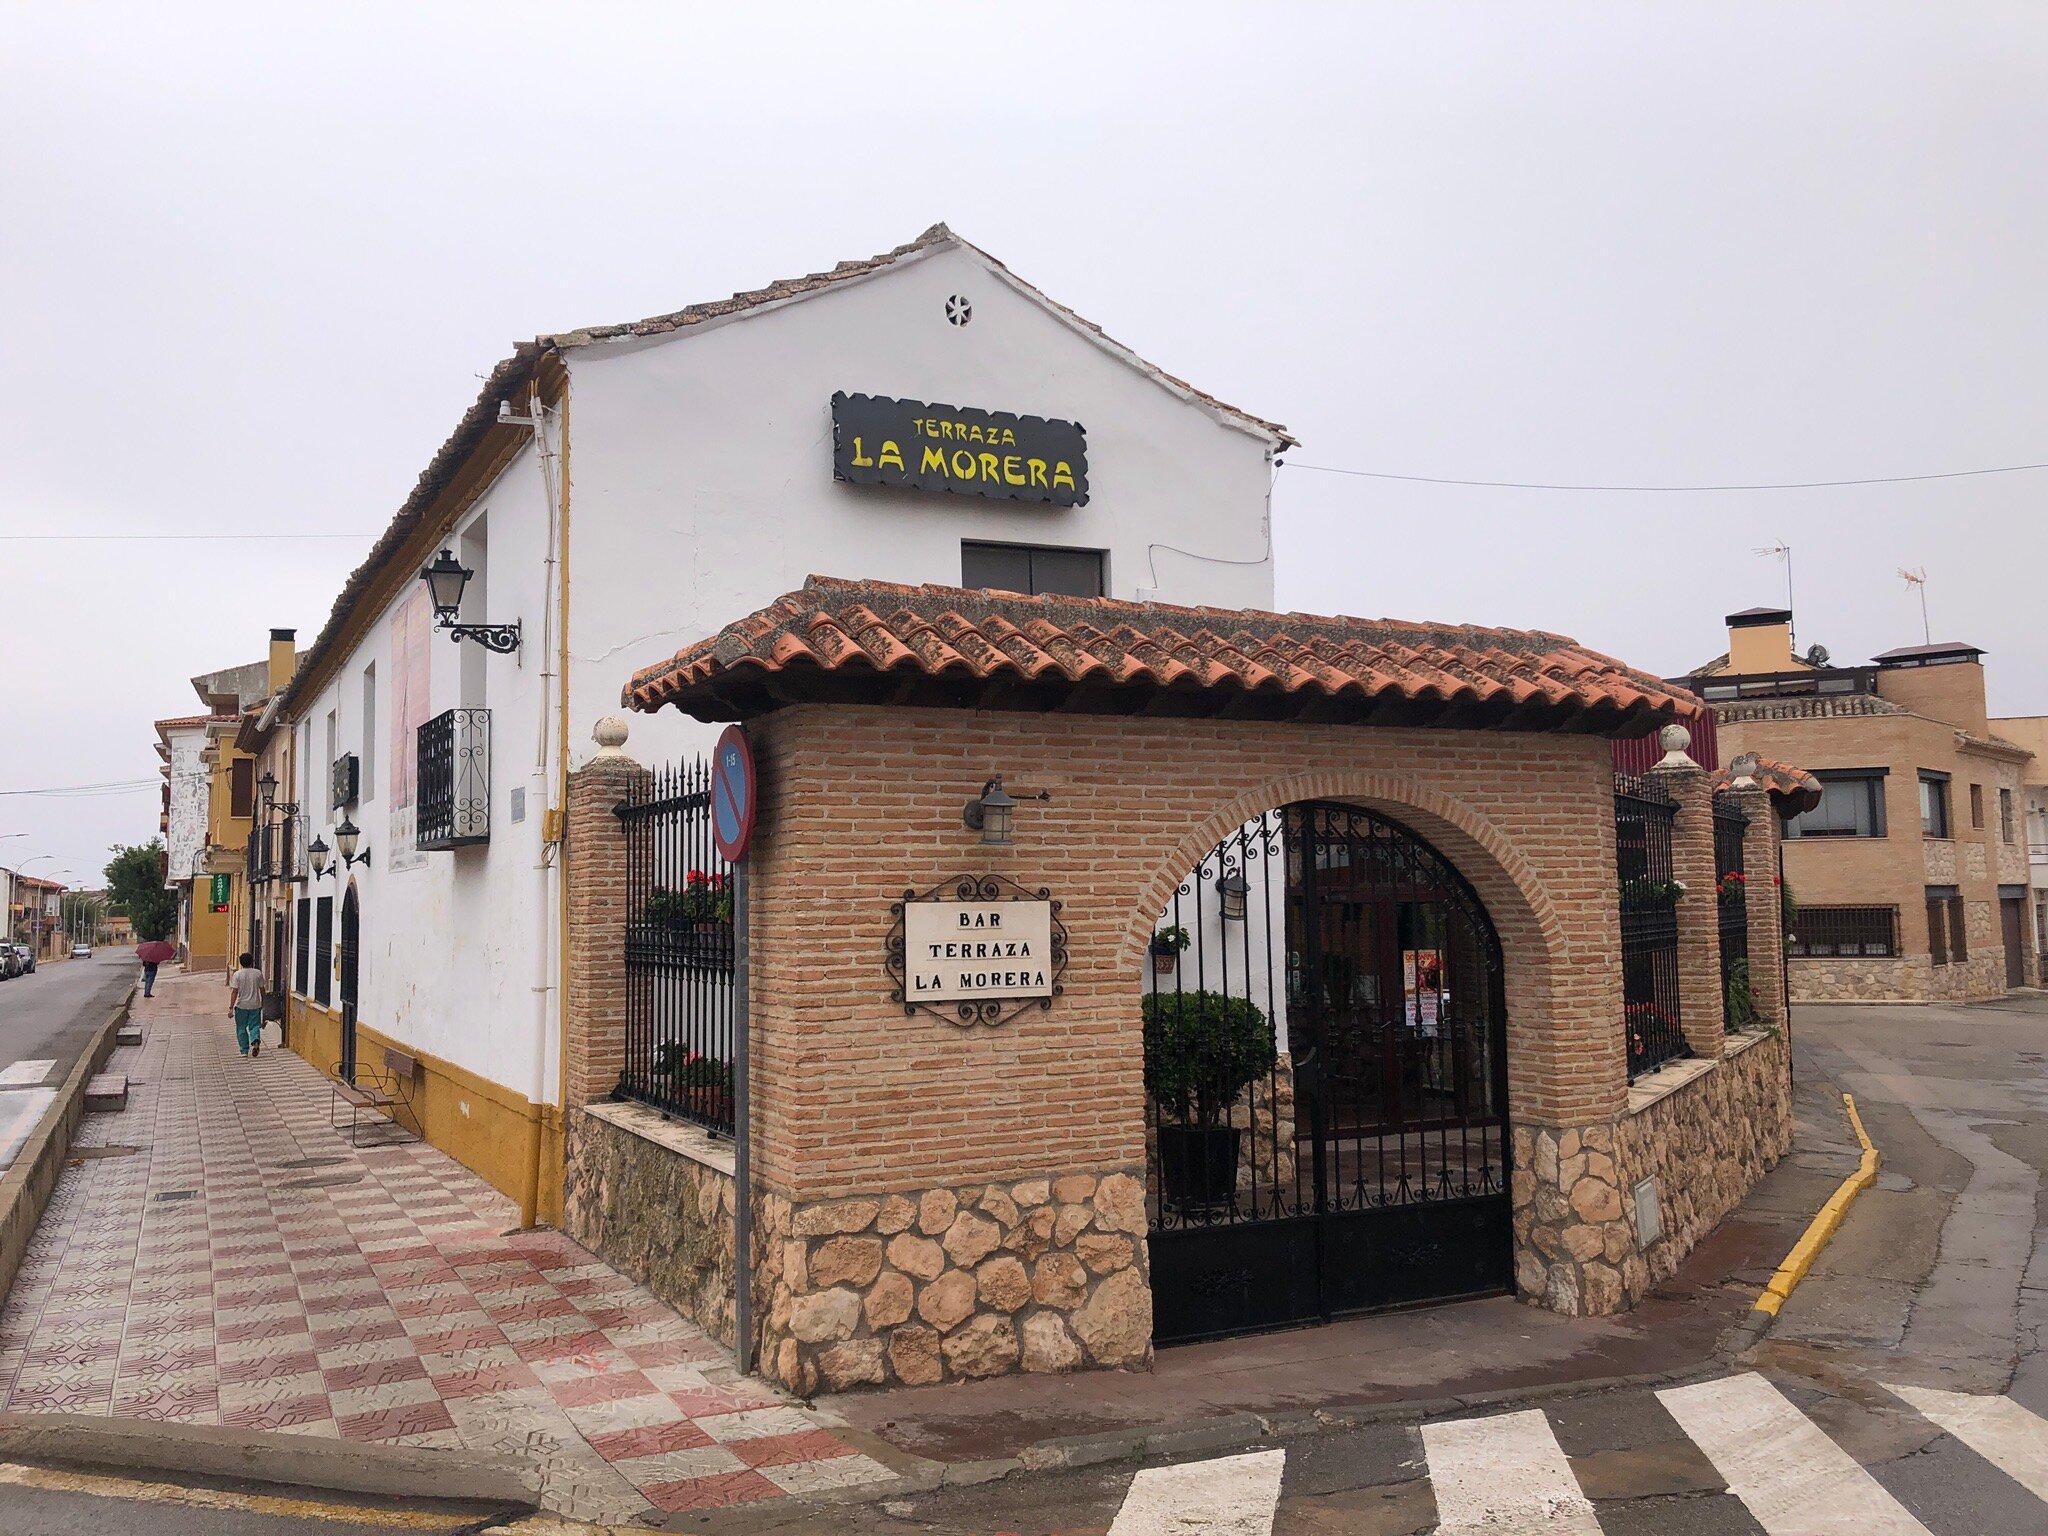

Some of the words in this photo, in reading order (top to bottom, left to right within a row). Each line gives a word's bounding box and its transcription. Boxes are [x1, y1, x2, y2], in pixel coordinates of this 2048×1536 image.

[913, 418, 1016, 447] TERRAZA
[850, 436, 905, 472] LA
[920, 445, 1076, 492] MORERA
[959, 913, 1001, 928] BAR
[929, 942, 1031, 959] TERRAZA
[915, 974, 942, 990] LA
[960, 971, 1045, 988] MORERA
